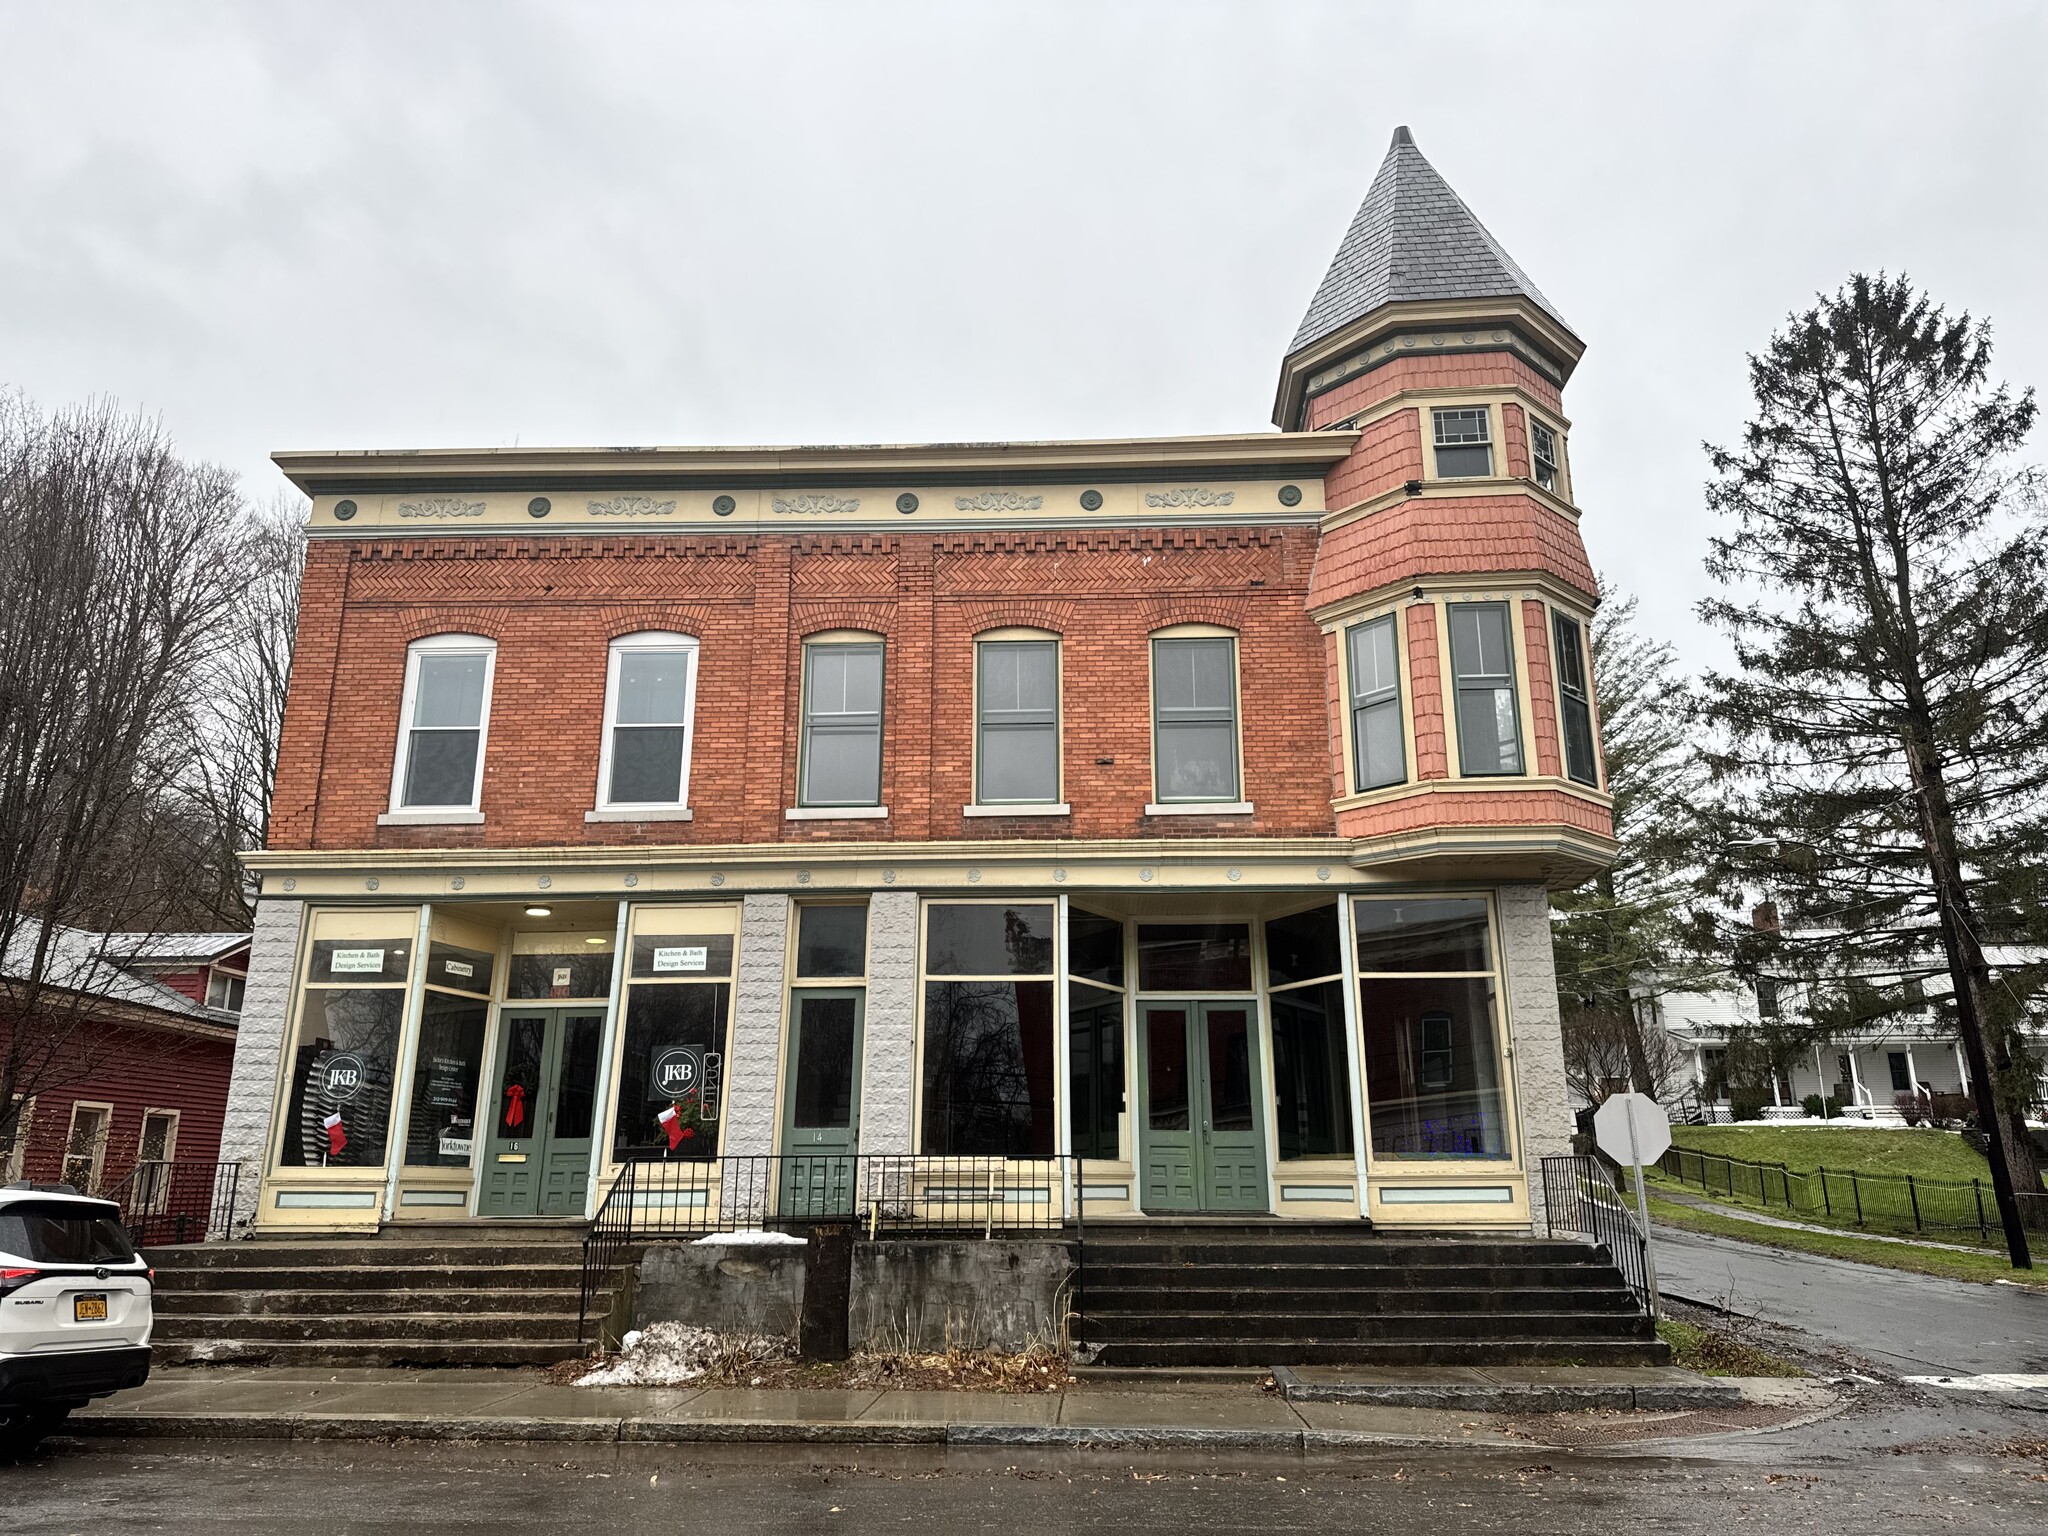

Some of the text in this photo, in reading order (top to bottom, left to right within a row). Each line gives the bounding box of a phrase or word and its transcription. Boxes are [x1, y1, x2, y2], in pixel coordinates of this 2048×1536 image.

[335, 962, 356, 970] Design
[446, 962, 471, 975] Cabinetry
[657, 960, 679, 968] Design
[813, 1131, 823, 1143] 14
[509, 1142, 519, 1151] 16
